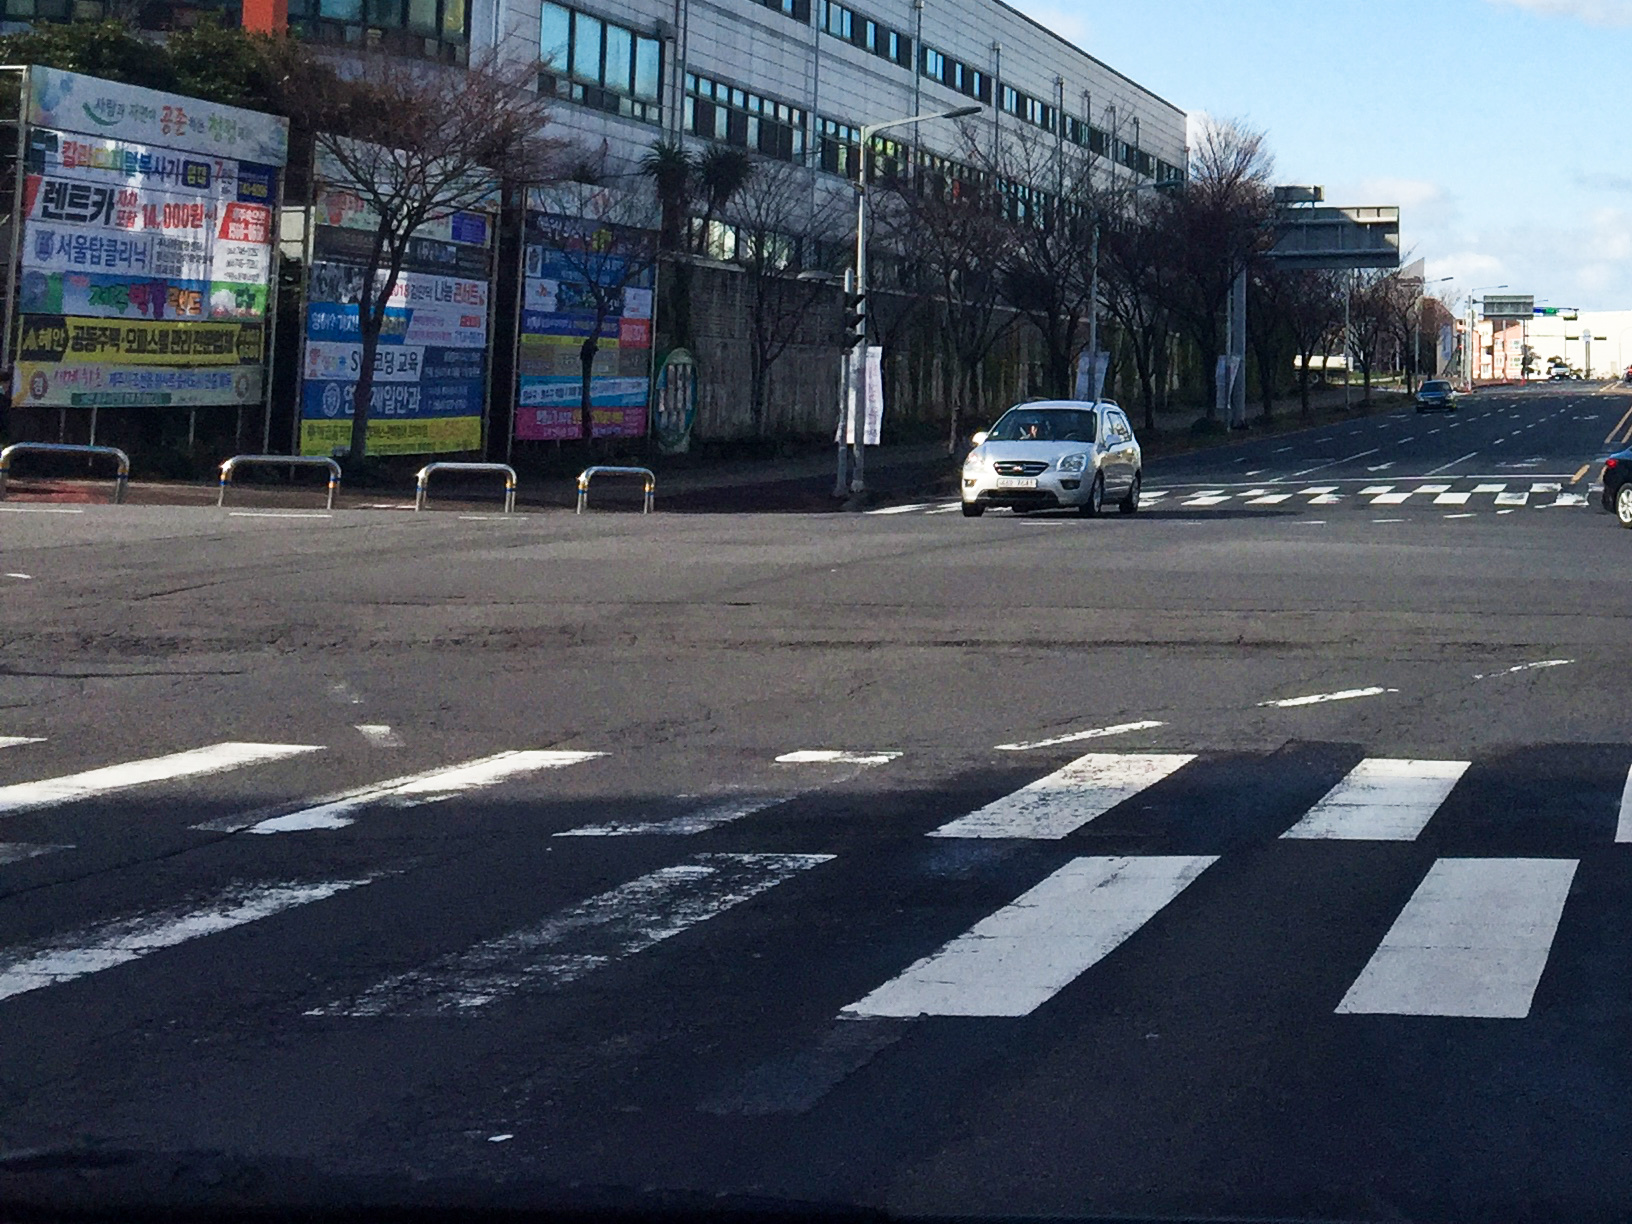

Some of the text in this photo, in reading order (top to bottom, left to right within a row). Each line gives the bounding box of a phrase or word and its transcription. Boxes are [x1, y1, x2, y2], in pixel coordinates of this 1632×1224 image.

[41, 180, 116, 226] 렌트카
[397, 352, 419, 376] 교육
[343, 384, 421, 415] 연제일안과
